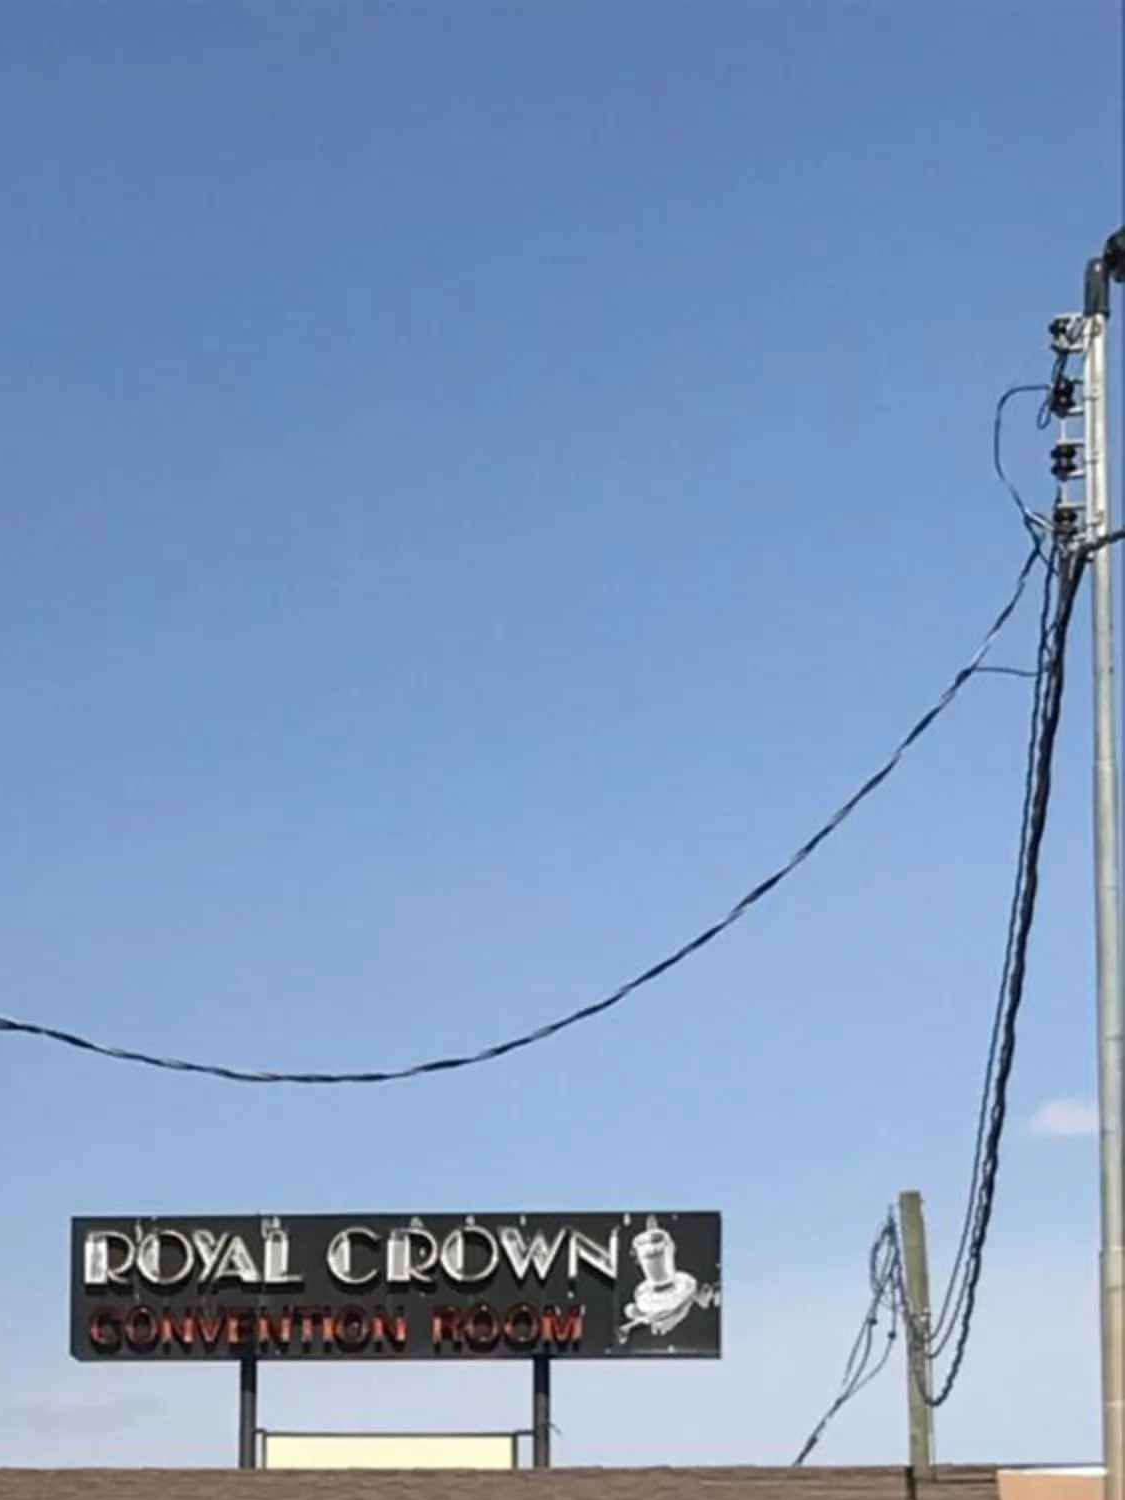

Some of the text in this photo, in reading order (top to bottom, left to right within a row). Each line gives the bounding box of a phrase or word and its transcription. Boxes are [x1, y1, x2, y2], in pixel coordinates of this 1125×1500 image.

[84, 1226, 619, 1285] ROYAL CROWN
[89, 1302, 585, 1346] CONVENTION ROOM
